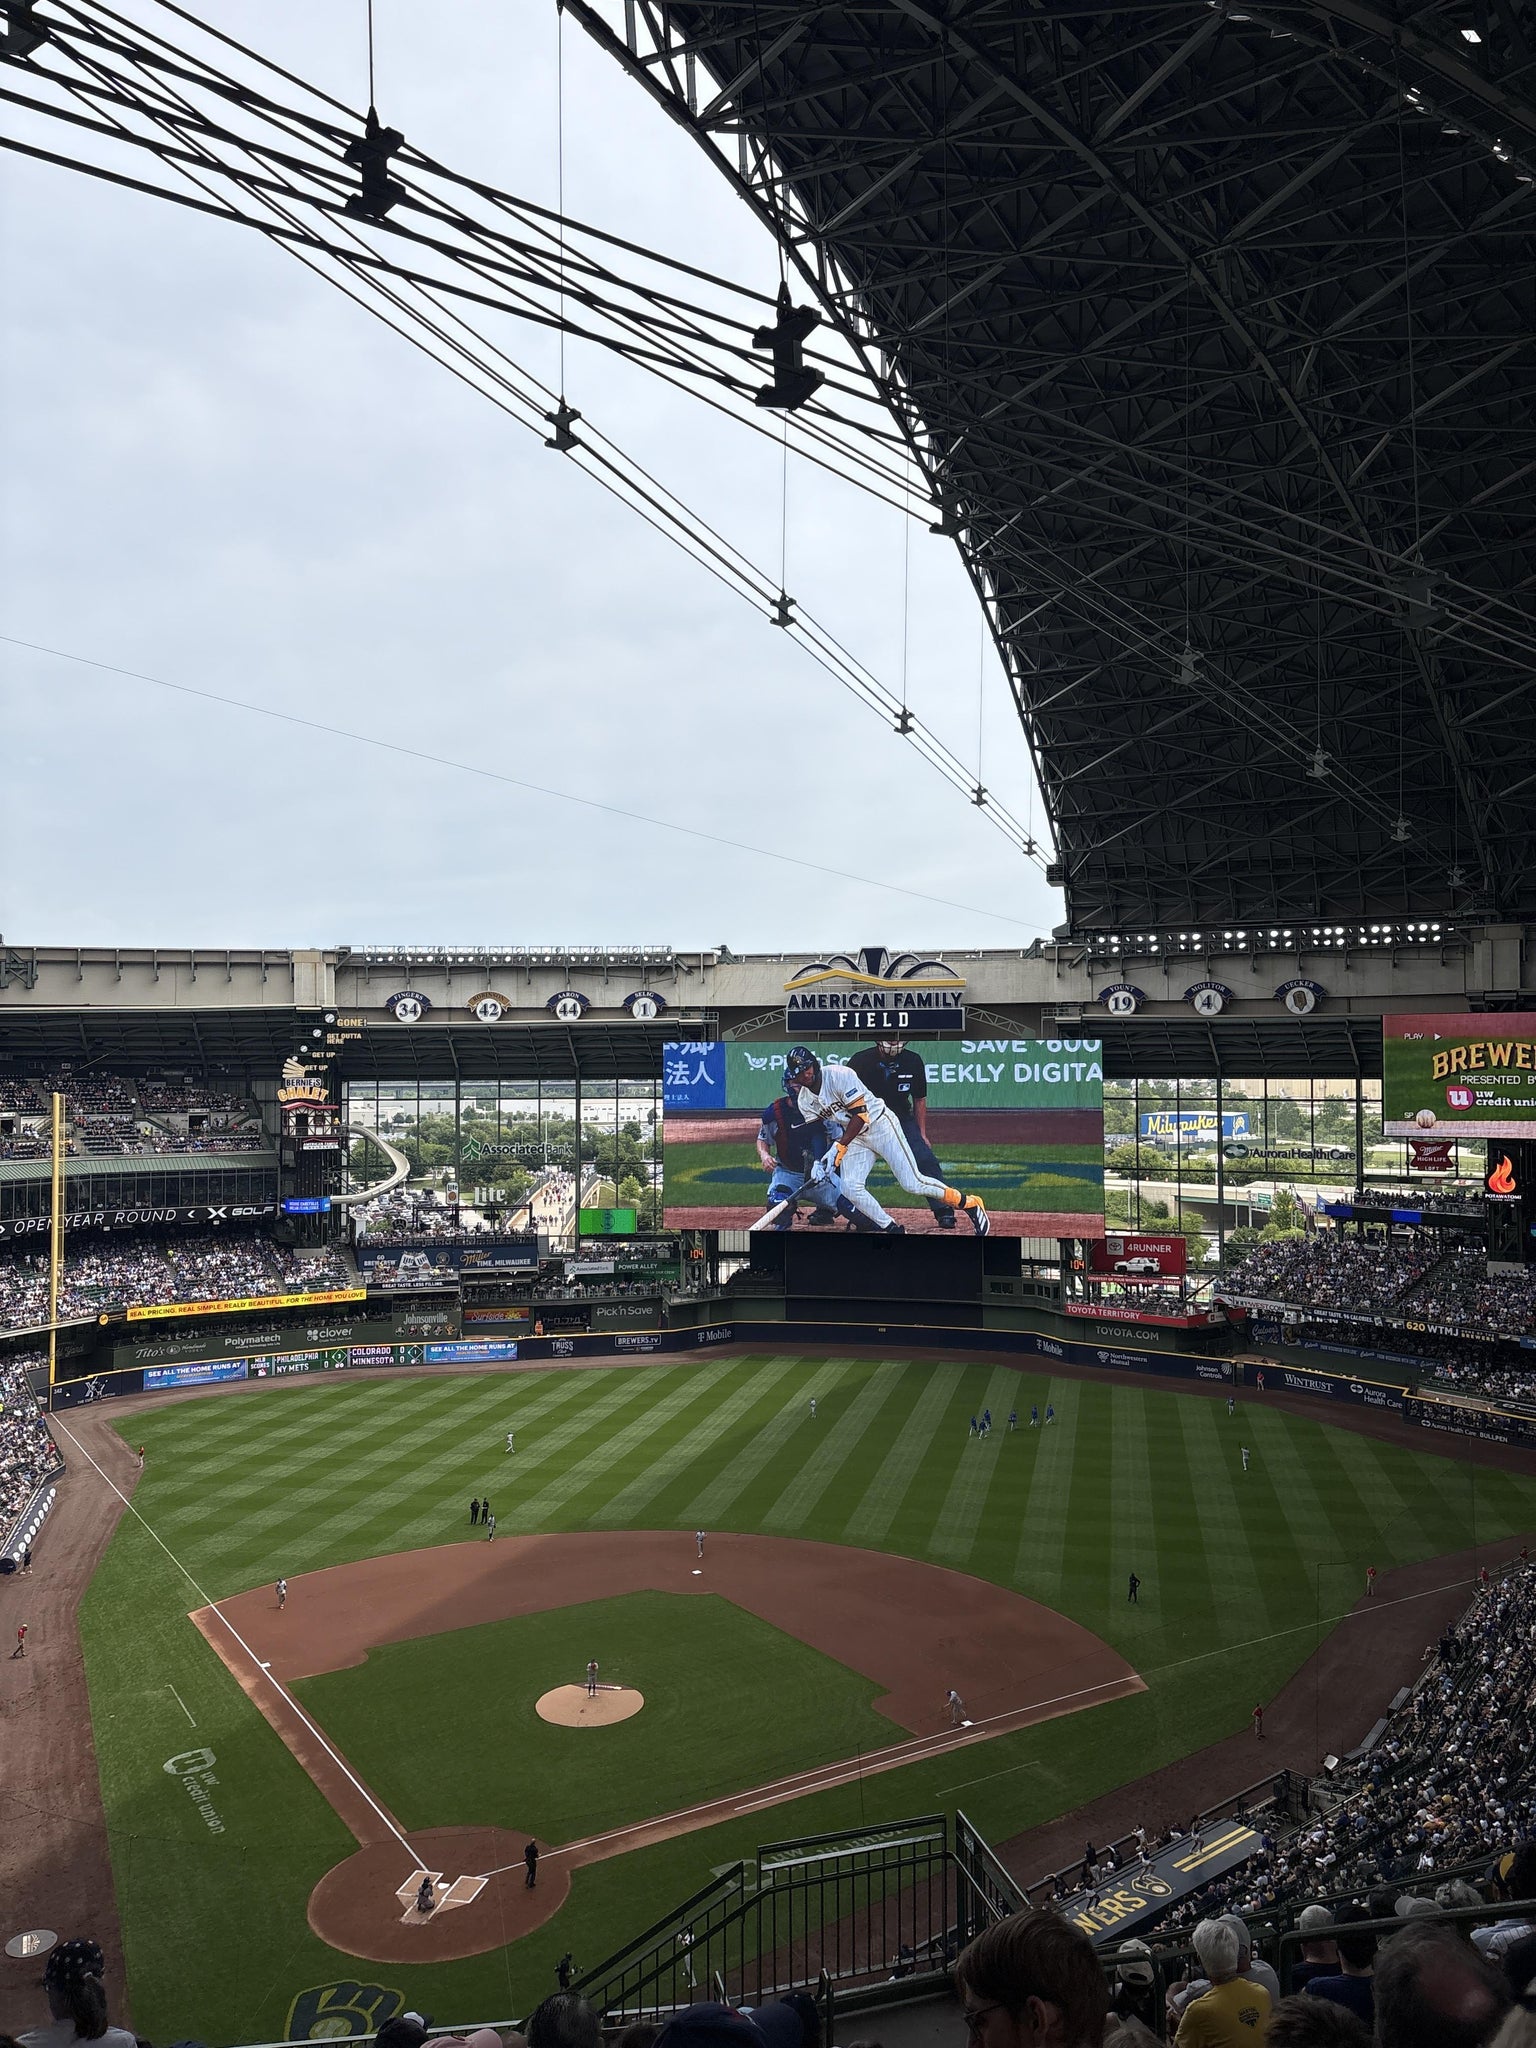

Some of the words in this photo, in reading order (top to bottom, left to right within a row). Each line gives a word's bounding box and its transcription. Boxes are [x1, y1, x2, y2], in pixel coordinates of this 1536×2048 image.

[1191, 983, 1226, 993] MOLITOR
[1285, 980, 1314, 989] UECKER
[393, 991, 423, 1001] FINGERS
[557, 991, 580, 999] AARON
[788, 992, 885, 1009] AMERICAN
[893, 992, 963, 1008] FAMILY
[1112, 996, 1132, 1012] 19
[1200, 994, 1212, 1010] 4
[399, 1003, 418, 1017] 34
[479, 1003, 499, 1017] 42
[559, 1003, 578, 1017] 44
[640, 1003, 650, 1016] 1
[337, 1019, 367, 1027] GONE!
[838, 1012, 909, 1027] FIELD
[961, 1040, 1028, 1053] SAVE
[1032, 1040, 1101, 1053] 600
[1432, 1042, 1536, 1080] BREWE
[925, 1063, 1005, 1083] EEKLY
[1014, 1063, 1102, 1083] DIGITA
[286, 1078, 321, 1087] BERNIE'S
[1460, 1075, 1521, 1085] PRESENTED
[277, 1086, 329, 1102] CHALET
[1476, 1090, 1494, 1098] uw
[1476, 1098, 1511, 1106] credit
[1254, 1148, 1288, 1159] Aurora
[1291, 1148, 1327, 1160] Health
[1330, 1149, 1356, 1160] Care
[474, 1186, 506, 1206] Lite
[64, 1213, 105, 1228] YEAR
[114, 1209, 177, 1224] ROUND
[231, 1206, 275, 1216] GOLF
[1127, 1243, 1172, 1253] 4RUNNER
[460, 1252, 492, 1267] Miller
[495, 1258, 531, 1267] MILWAUKEE
[596, 1306, 618, 1317] Pick
[628, 1306, 653, 1315] Save
[1067, 1306, 1096, 1315] TOYOTA
[1098, 1308, 1140, 1320] TERRITORY
[403, 1313, 448, 1325] Johnsonville
[318, 1327, 353, 1339] clover
[706, 1328, 732, 1342] Mobile
[1096, 1325, 1159, 1341] TOYOTA.COM
[1406, 1321, 1425, 1332] 620
[1428, 1325, 1459, 1337] WTMJ
[224, 1334, 281, 1346] Polymatech
[1461, 1333, 1495, 1342] BREWERS
[352, 1346, 391, 1356] COLORADO
[399, 1346, 405, 1354] 0
[551, 1341, 574, 1351] TRUSS
[1043, 1340, 1063, 1357] Mobile
[135, 1346, 165, 1359] Tito's
[276, 1352, 319, 1364] PHILADELPHIA
[1110, 1353, 1148, 1363] Northwestern
[352, 1356, 394, 1366] MINNESOTA
[399, 1355, 405, 1364] 0
[1110, 1358, 1130, 1366] Mutual
[276, 1366, 286, 1374] NY
[288, 1362, 309, 1372] METS
[323, 1361, 329, 1369] 0
[1196, 1365, 1218, 1373] Johnson
[148, 1370, 161, 1378] SEE
[1200, 1370, 1223, 1380] Controls
[1284, 1373, 1334, 1391] WINTRUST
[1364, 1387, 1387, 1398] Aurora
[1364, 1395, 1387, 1406] Health
[1387, 1399, 1403, 1409] Care
[1431, 1422, 1448, 1432] Aurora
[1448, 1425, 1464, 1435] Health
[1465, 1428, 1477, 1437] Care
[1480, 1431, 1509, 1443] BULLPEN
[200, 1771, 221, 1786] uw
[182, 1776, 210, 1804] credit
[198, 1803, 226, 1834] union
